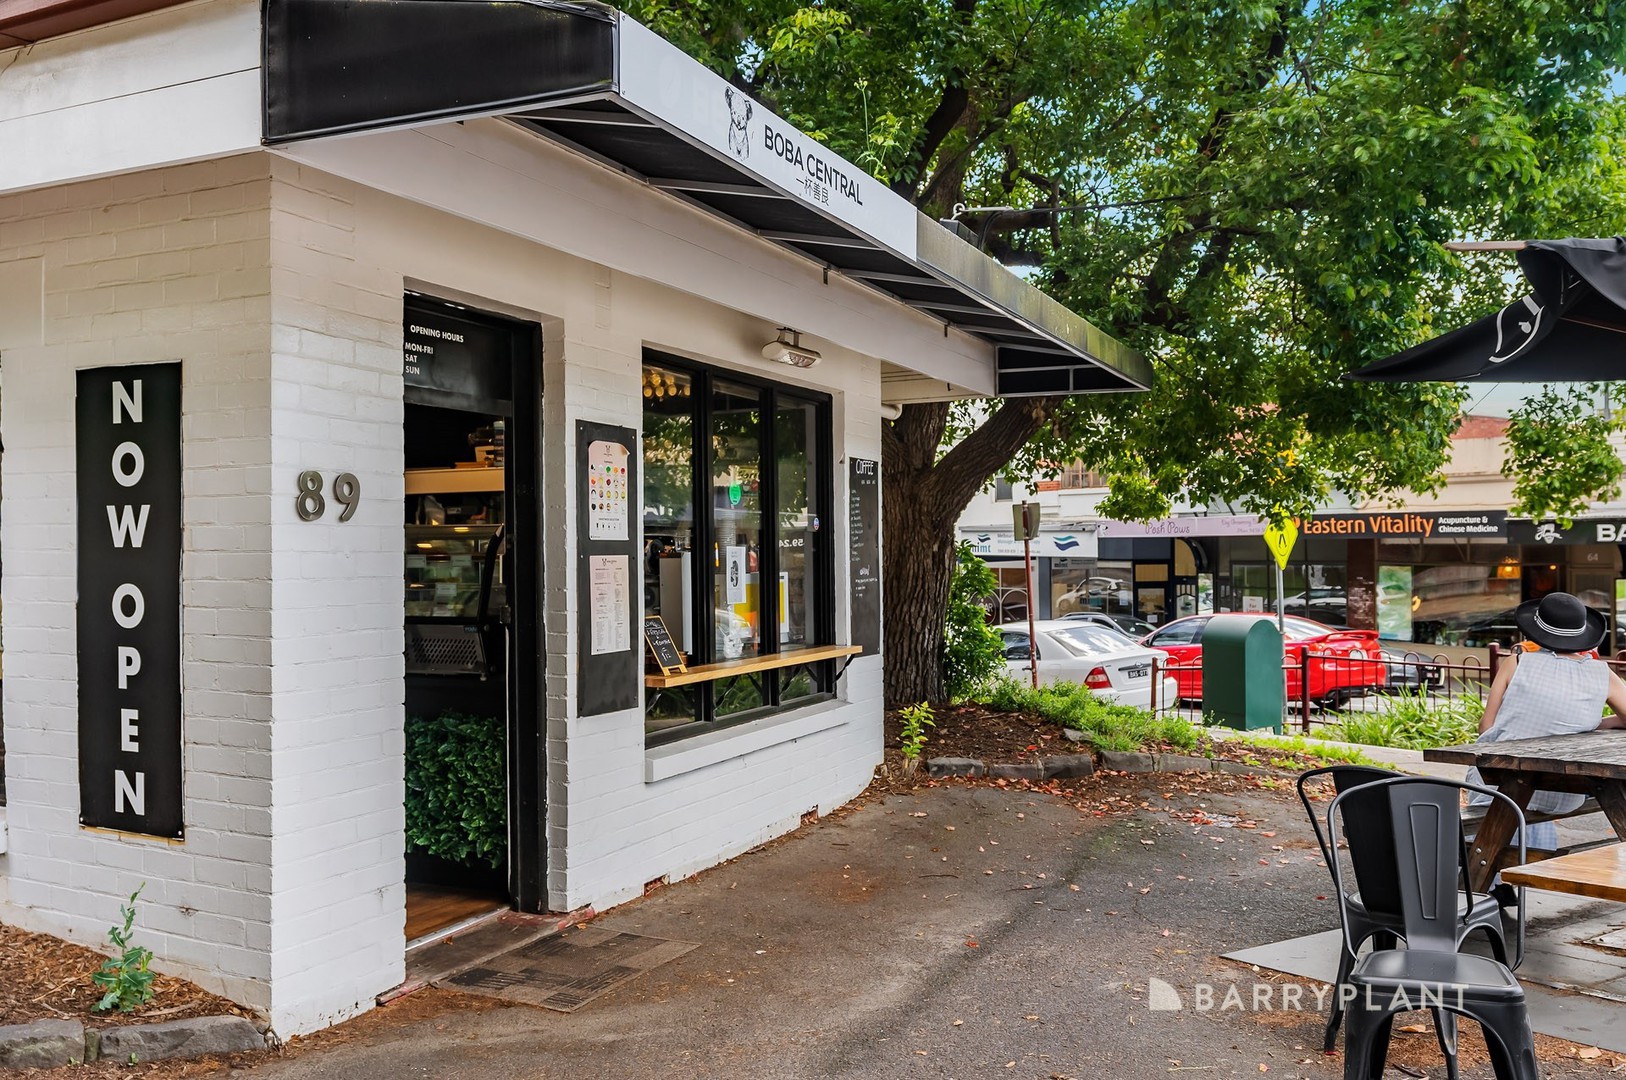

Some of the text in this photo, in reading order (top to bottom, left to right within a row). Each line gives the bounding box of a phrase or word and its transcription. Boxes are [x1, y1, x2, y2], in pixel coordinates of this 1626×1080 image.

[764, 124, 863, 206] BOBA CENTRAL
[410, 324, 464, 343] OPENING HOURS
[404, 341, 434, 354] MON-FRI
[405, 353, 418, 363] SAT
[405, 365, 420, 375] SUN
[855, 458, 874, 476] COFFEE
[295, 470, 361, 523] 89
[1303, 514, 1434, 538] Eastern Vitality
[1438, 516, 1489, 525] Acupuncture &
[1145, 521, 1190, 535] Posh Paws
[1438, 525, 1499, 533] Chinese Medicine
[1586, 552, 1599, 562] 64
[106, 379, 151, 816] NOW OPEN
